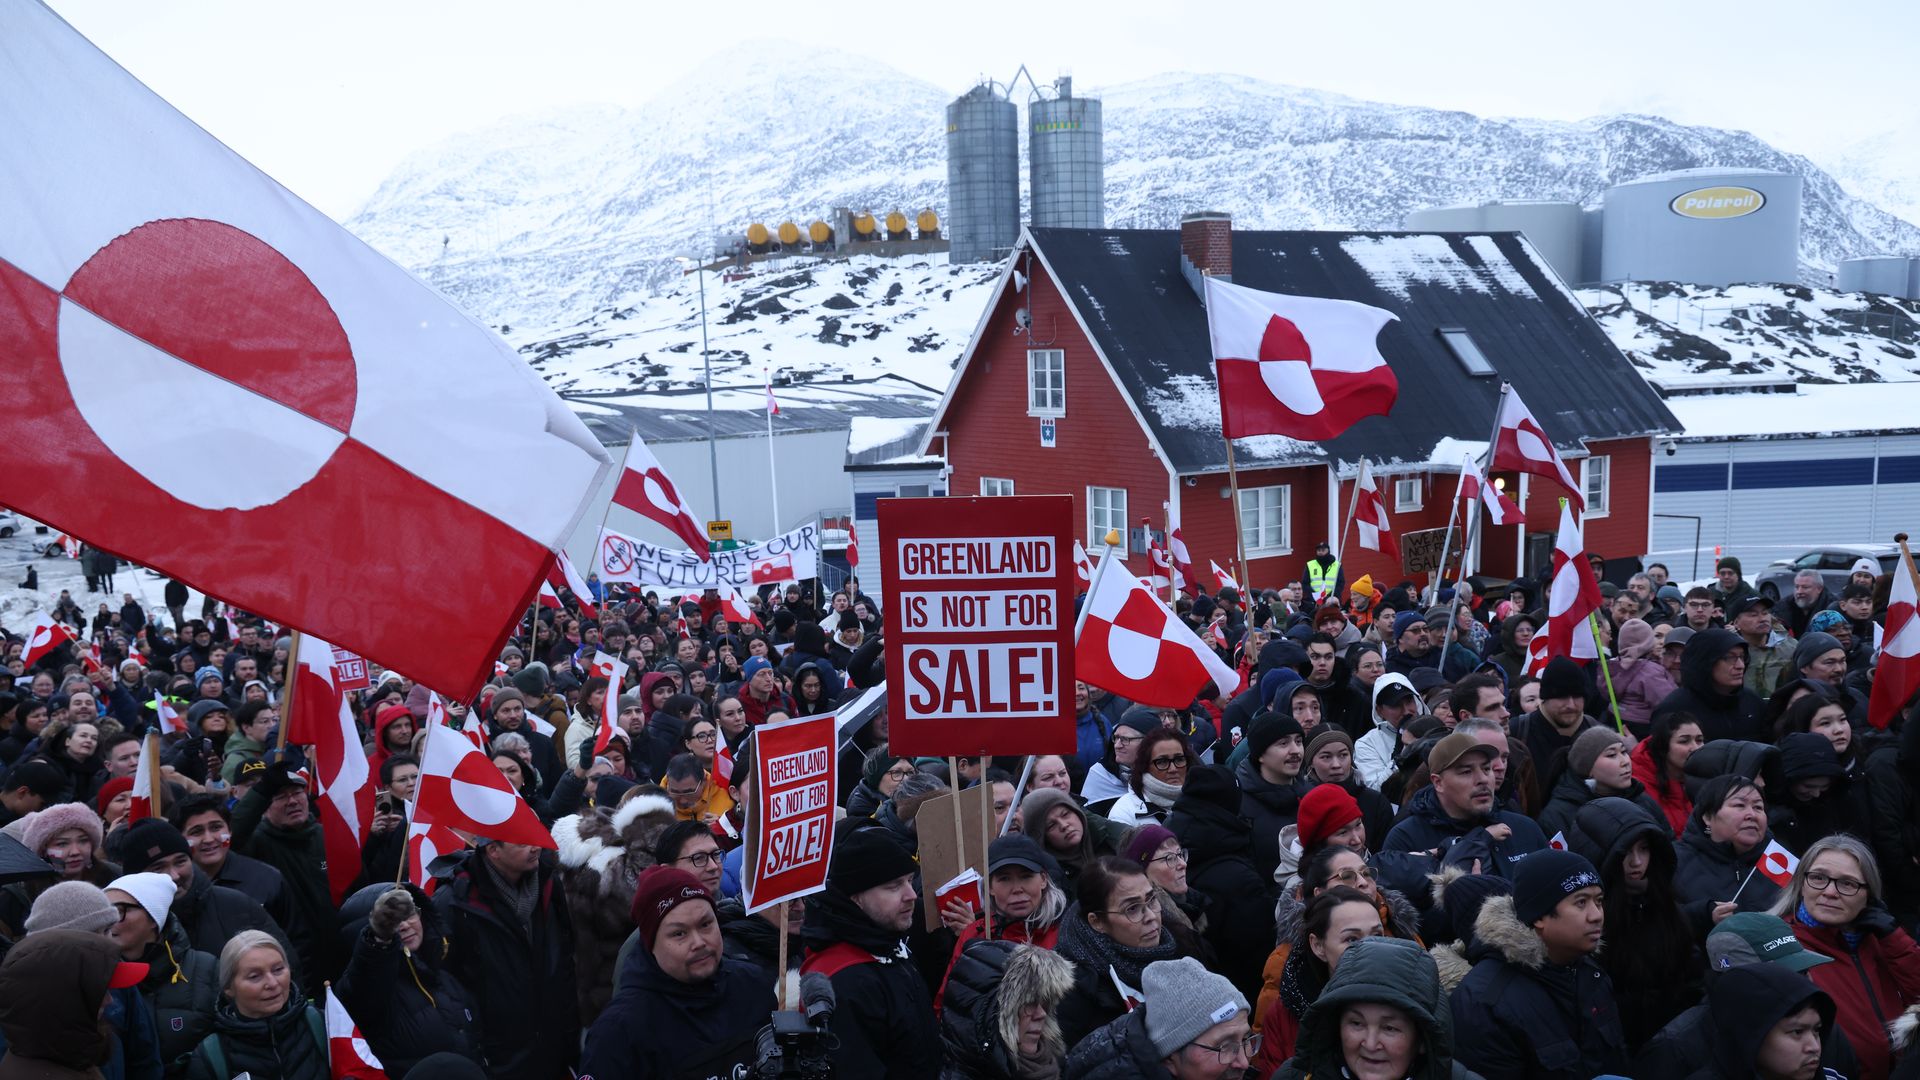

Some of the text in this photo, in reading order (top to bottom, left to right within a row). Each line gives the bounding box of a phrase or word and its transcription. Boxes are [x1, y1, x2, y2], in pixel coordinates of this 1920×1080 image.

[1685, 194, 1754, 209] Polaroil
[630, 541, 672, 562] WE
[766, 526, 816, 555] OUR
[903, 541, 1051, 575] GREENLAND
[634, 557, 748, 586] FUTURE
[905, 594, 1052, 627] IS NOT FOR
[337, 661, 364, 679] ALE!
[908, 647, 1054, 714] SALE!
[770, 750, 826, 783] GREENLAND
[772, 784, 826, 818] IS NOT FOR
[766, 817, 825, 875] SALE!
